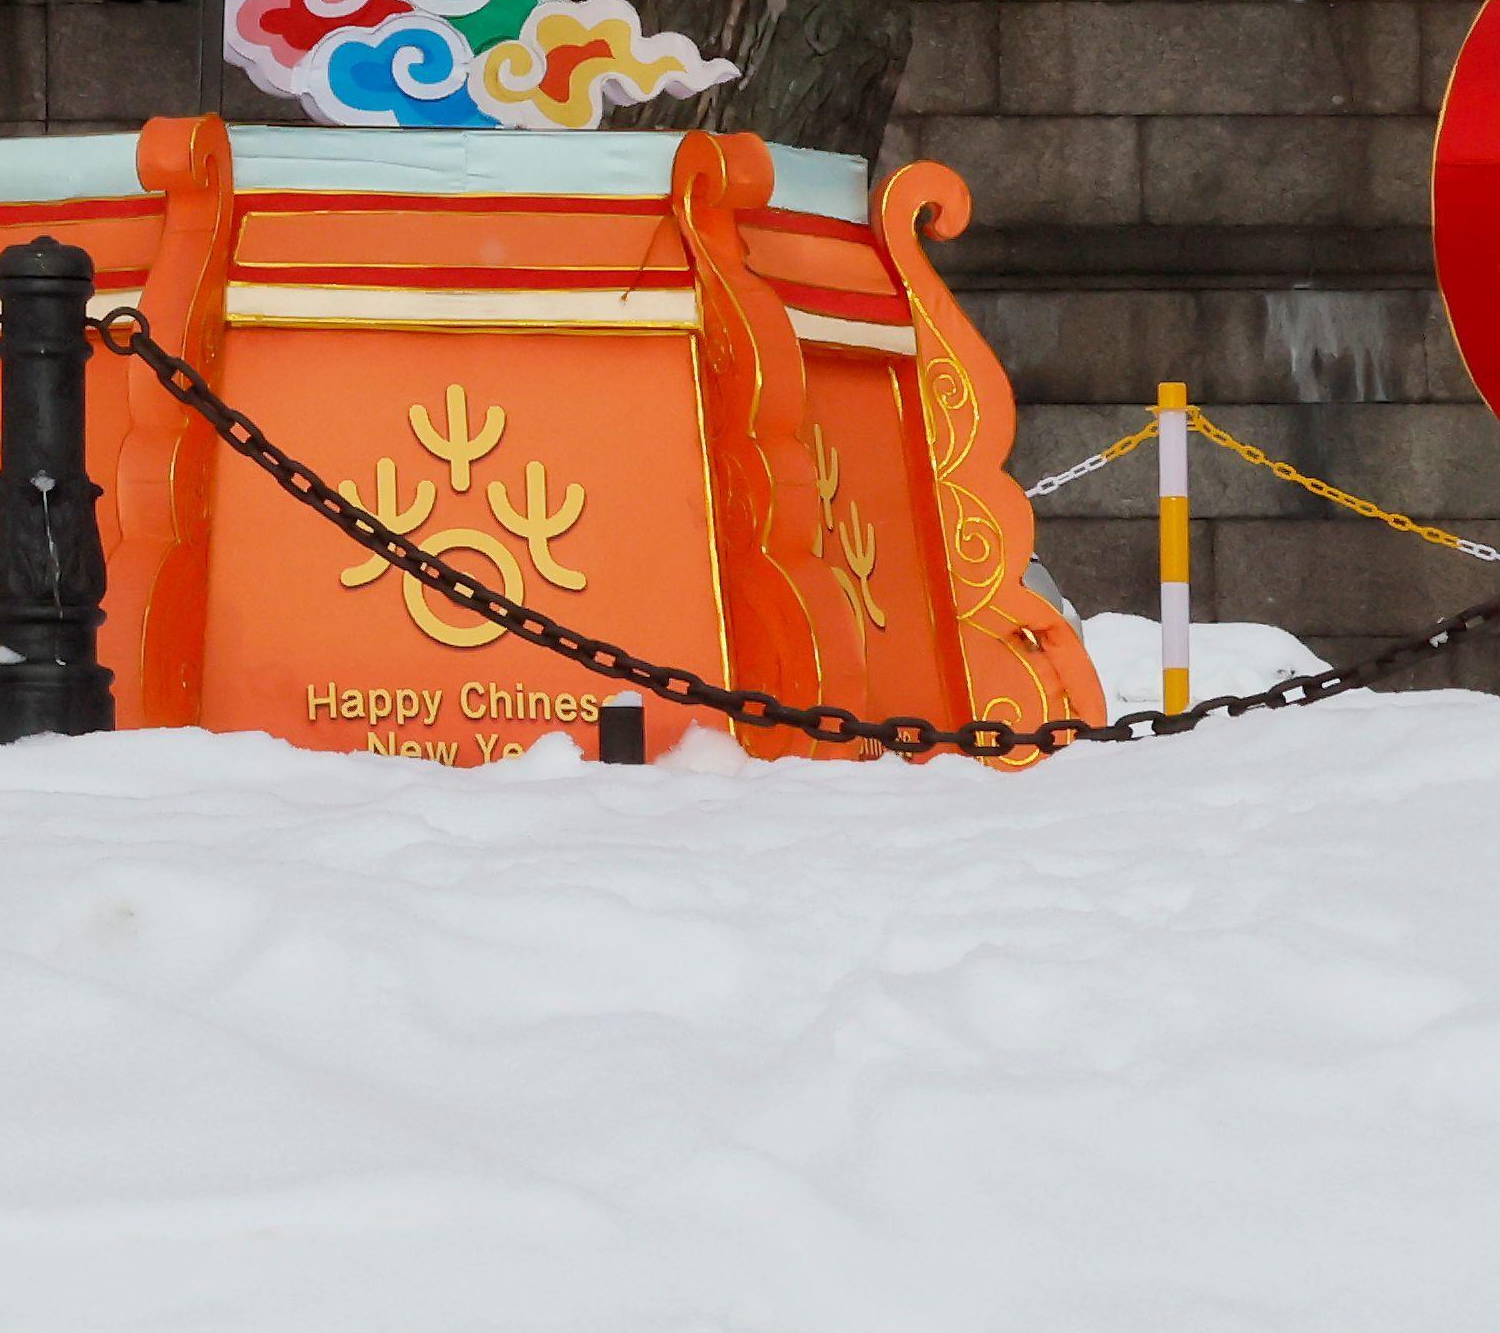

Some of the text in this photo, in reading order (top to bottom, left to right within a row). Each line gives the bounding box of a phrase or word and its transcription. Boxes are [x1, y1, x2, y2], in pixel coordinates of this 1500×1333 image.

[307, 681, 616, 725] Happy Chines
[475, 733, 526, 764] Ye
